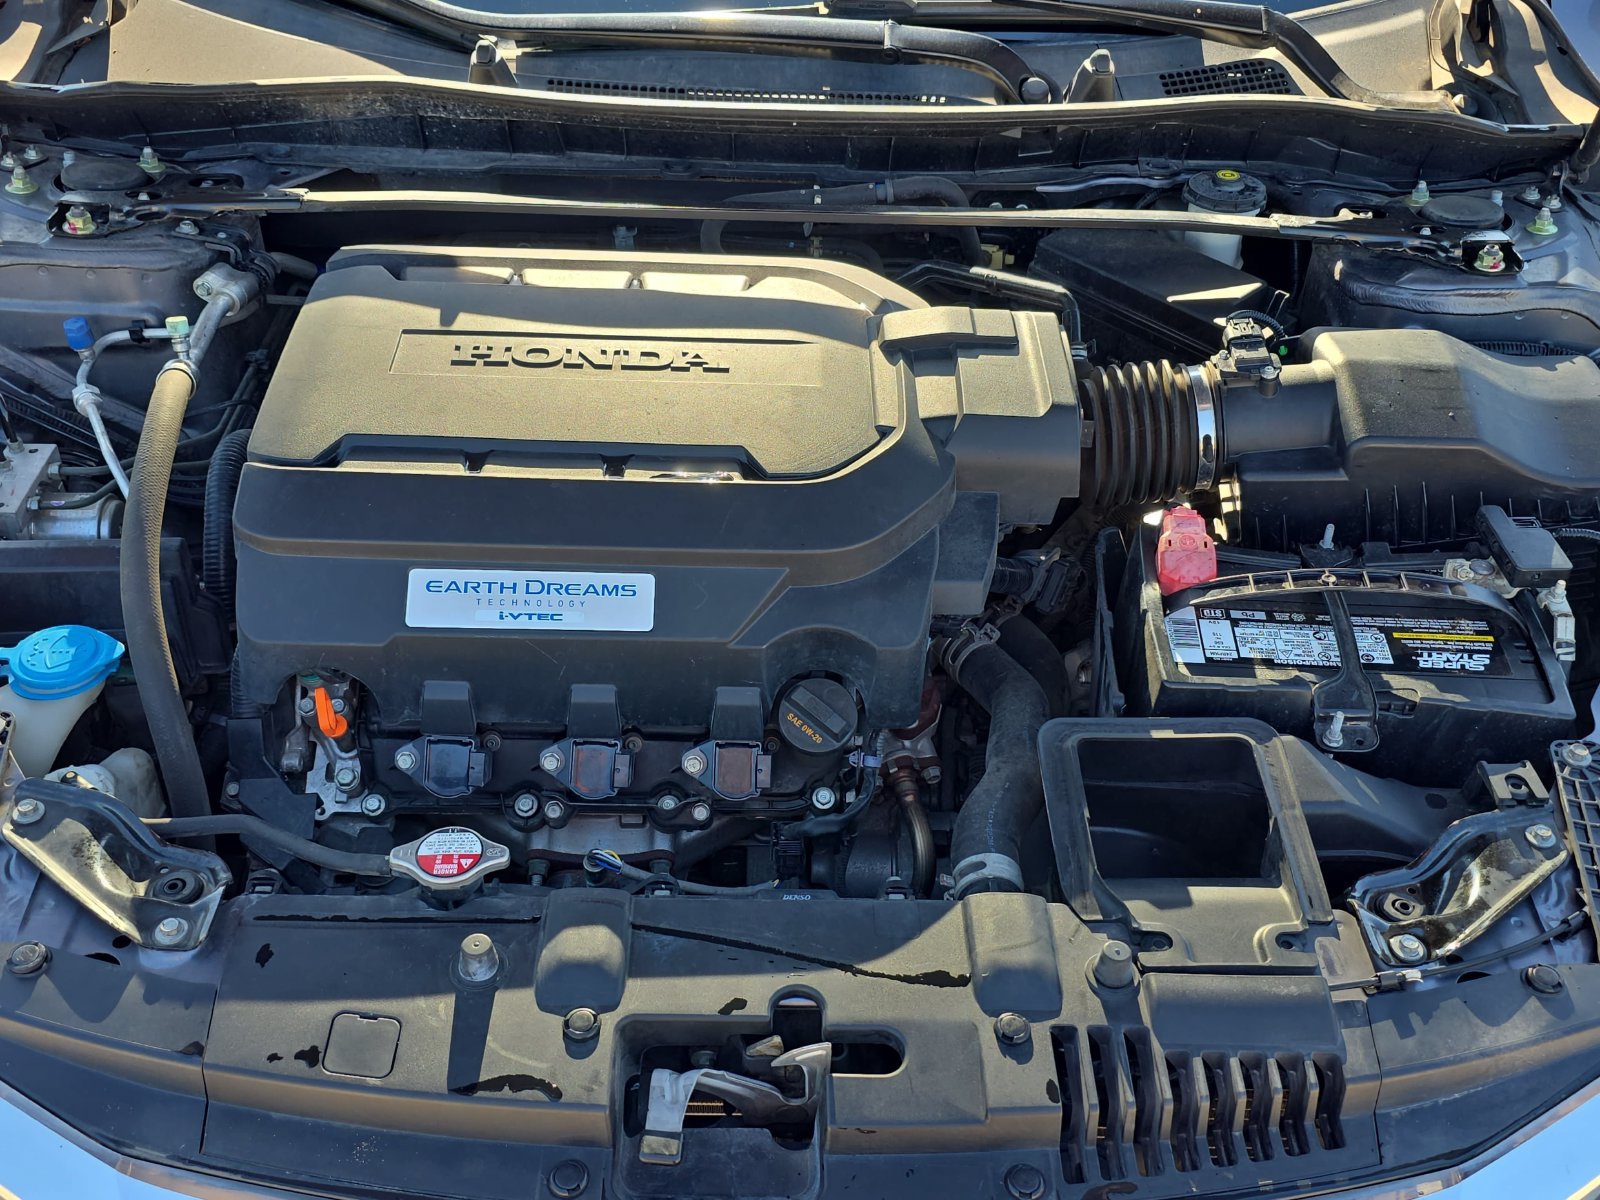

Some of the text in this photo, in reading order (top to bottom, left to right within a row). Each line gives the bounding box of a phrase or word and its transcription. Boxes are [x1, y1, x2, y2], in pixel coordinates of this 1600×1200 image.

[451, 344, 730, 373] HONDA
[425, 579, 637, 597] EARTH DREAMS
[476, 598, 586, 608] TECHNOLOGY
[498, 611, 564, 622] i-VTEC
[1273, 659, 1342, 667] ANGER/POISON
[1416, 652, 1490, 665] START
[1418, 659, 1485, 671] SUPER
[787, 712, 822, 744] SAE 0W-20
